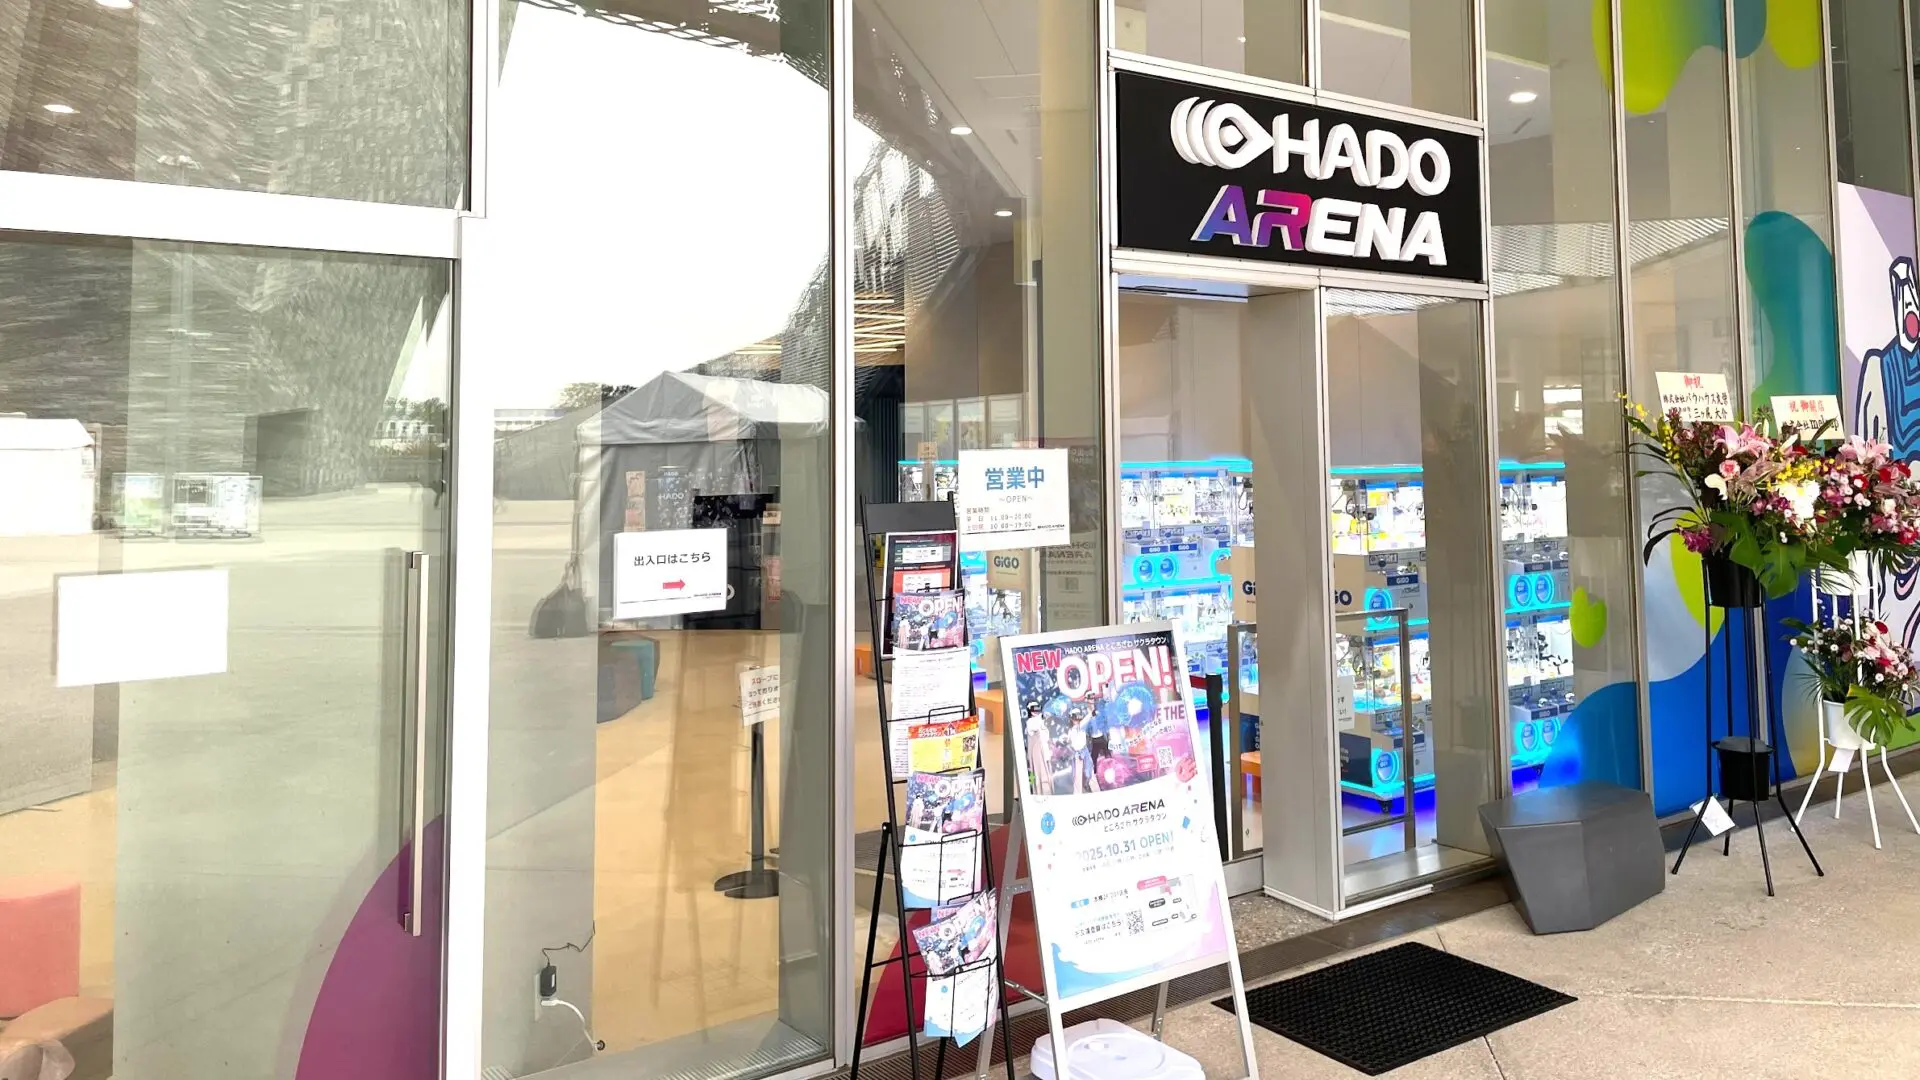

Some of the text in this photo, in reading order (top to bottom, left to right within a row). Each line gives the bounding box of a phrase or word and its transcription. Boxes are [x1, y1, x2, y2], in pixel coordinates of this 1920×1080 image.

[1272, 113, 1451, 196] HADO
[1190, 184, 1448, 266] ARENA
[984, 466, 1045, 491] 営業中
[634, 551, 711, 567] 出入口はこちら
[993, 555, 1020, 570] GiGO
[1064, 646, 1083, 655] HADO
[1084, 643, 1105, 653] ARENA
[1016, 645, 1173, 700] NEW OPEN!
[1164, 704, 1185, 720] THE
[1088, 799, 1165, 823] HADO ARENA
[1076, 840, 1136, 862] 2025.10.31
[1140, 831, 1174, 849] OPEN!
